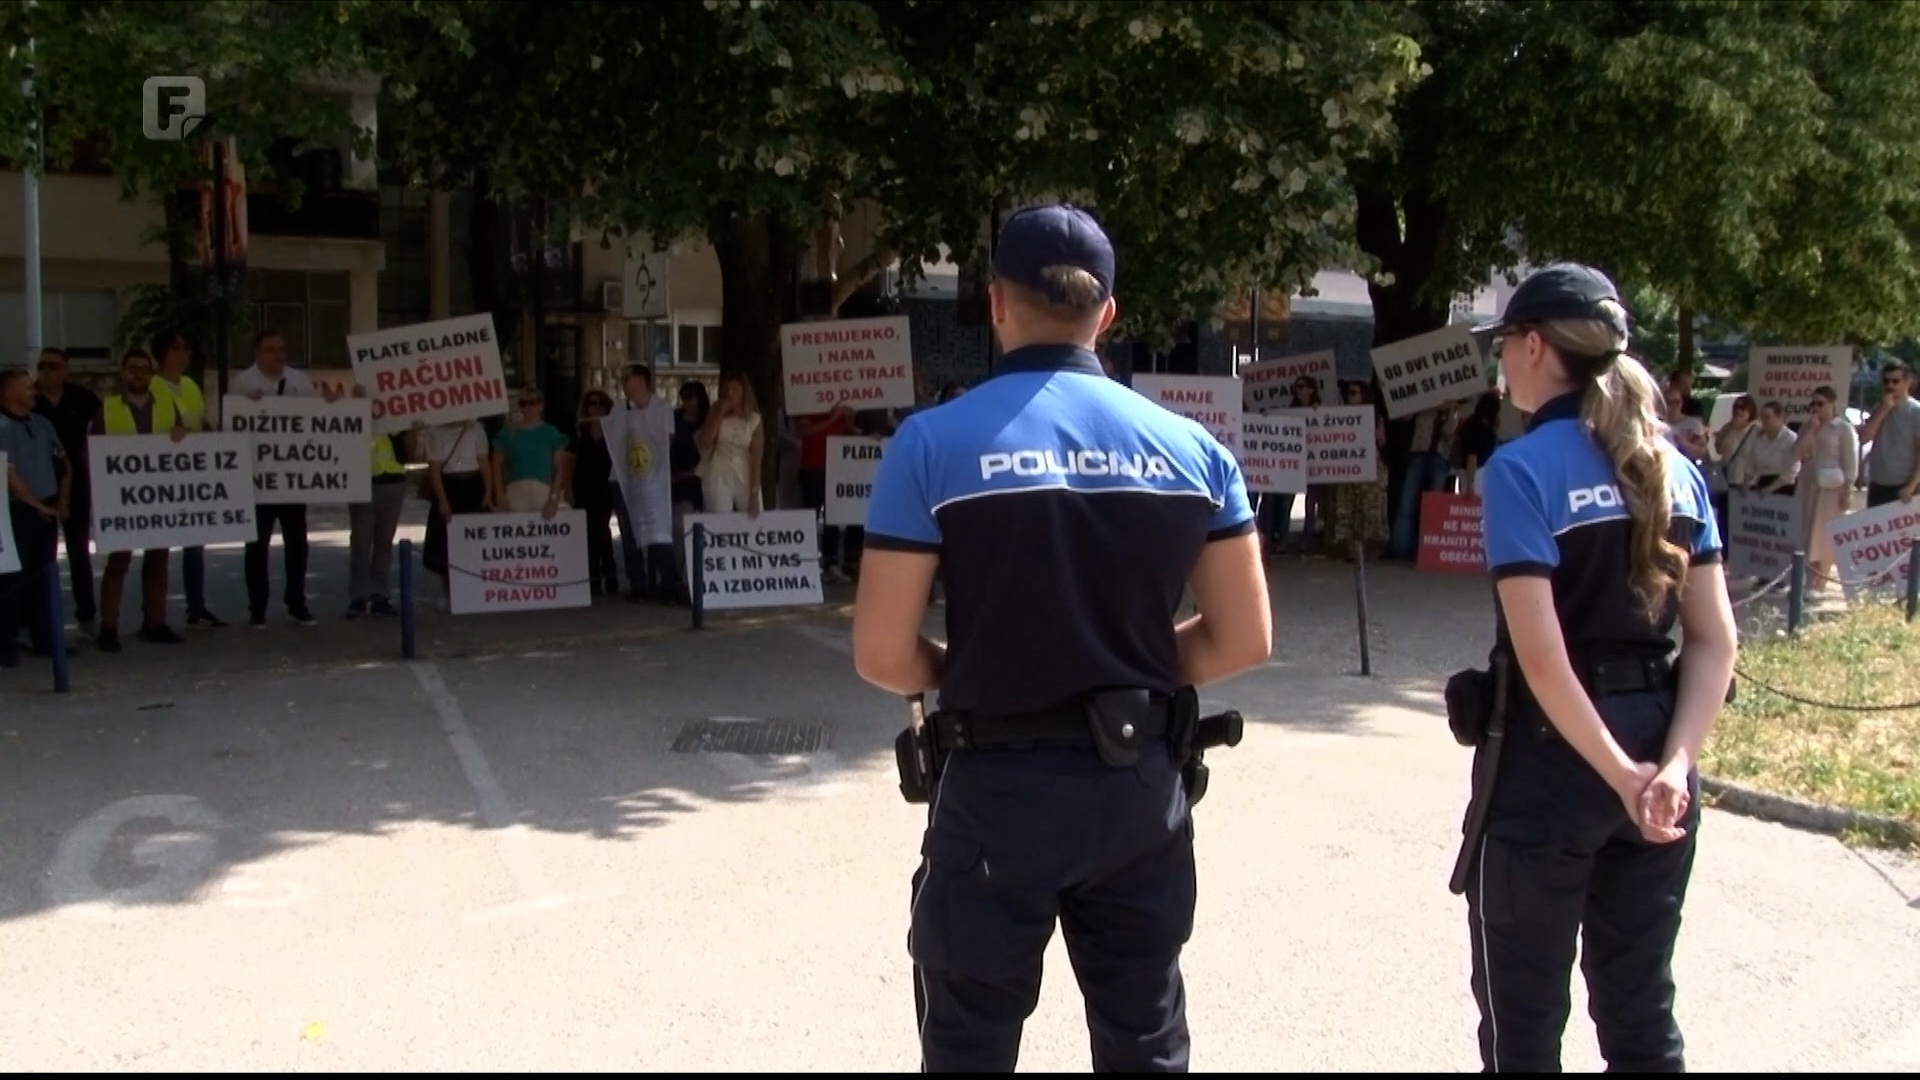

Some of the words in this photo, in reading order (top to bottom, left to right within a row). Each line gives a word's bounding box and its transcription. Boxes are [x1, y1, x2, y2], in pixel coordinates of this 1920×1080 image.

[357, 341, 413, 362] PLATE
[417, 328, 491, 352] GLADNE
[791, 327, 900, 347] PREMIJERKO,
[818, 352, 823, 364] I
[828, 348, 875, 362] NAMA
[376, 356, 483, 392] RAČUNI
[790, 368, 853, 385] MJESEC
[858, 365, 906, 380] TRAJE
[1243, 359, 1330, 384] NEPRAVDA
[1384, 363, 1402, 380] OD
[1405, 356, 1430, 374] OVE
[815, 391, 835, 403] 30
[840, 387, 884, 401] DANA
[1161, 390, 1213, 403] MANJE
[1254, 389, 1263, 400] U
[1389, 382, 1418, 402] NAM
[1420, 376, 1437, 393] SE
[1758, 387, 1775, 397] NE
[371, 379, 503, 419] OGROMNI
[232, 410, 304, 433] DIŽITE
[311, 416, 363, 433] NAM
[1323, 413, 1362, 427] ŽIVOT
[1282, 426, 1302, 437] STE
[843, 445, 882, 460] PLATA
[1262, 441, 1303, 453] POSAO
[1320, 448, 1367, 460] OBRAZ
[106, 451, 208, 475] KOLEGE
[215, 451, 238, 470] IZ
[980, 449, 1176, 481] POLICIJA
[1279, 460, 1299, 470] STE
[253, 473, 278, 490] NE
[285, 473, 347, 489] TLAK!
[121, 482, 228, 506] KONJICA
[101, 508, 217, 532] PRIDRUŽITE
[223, 509, 251, 524] SE.
[464, 525, 488, 540] NE
[492, 521, 571, 539] TRAŽIMO
[755, 527, 805, 546] ĆEMO
[1833, 528, 1859, 545] SVI
[1862, 523, 1883, 538] ZA
[482, 545, 555, 561] LUKSUZ,
[705, 556, 726, 571] SE
[732, 556, 737, 570] I
[742, 555, 762, 569] MI
[768, 553, 802, 568] VAS
[480, 563, 559, 582] TRAŽIMO
[485, 585, 557, 603] PRAVDU
[725, 576, 816, 593] IZBORIMA.
